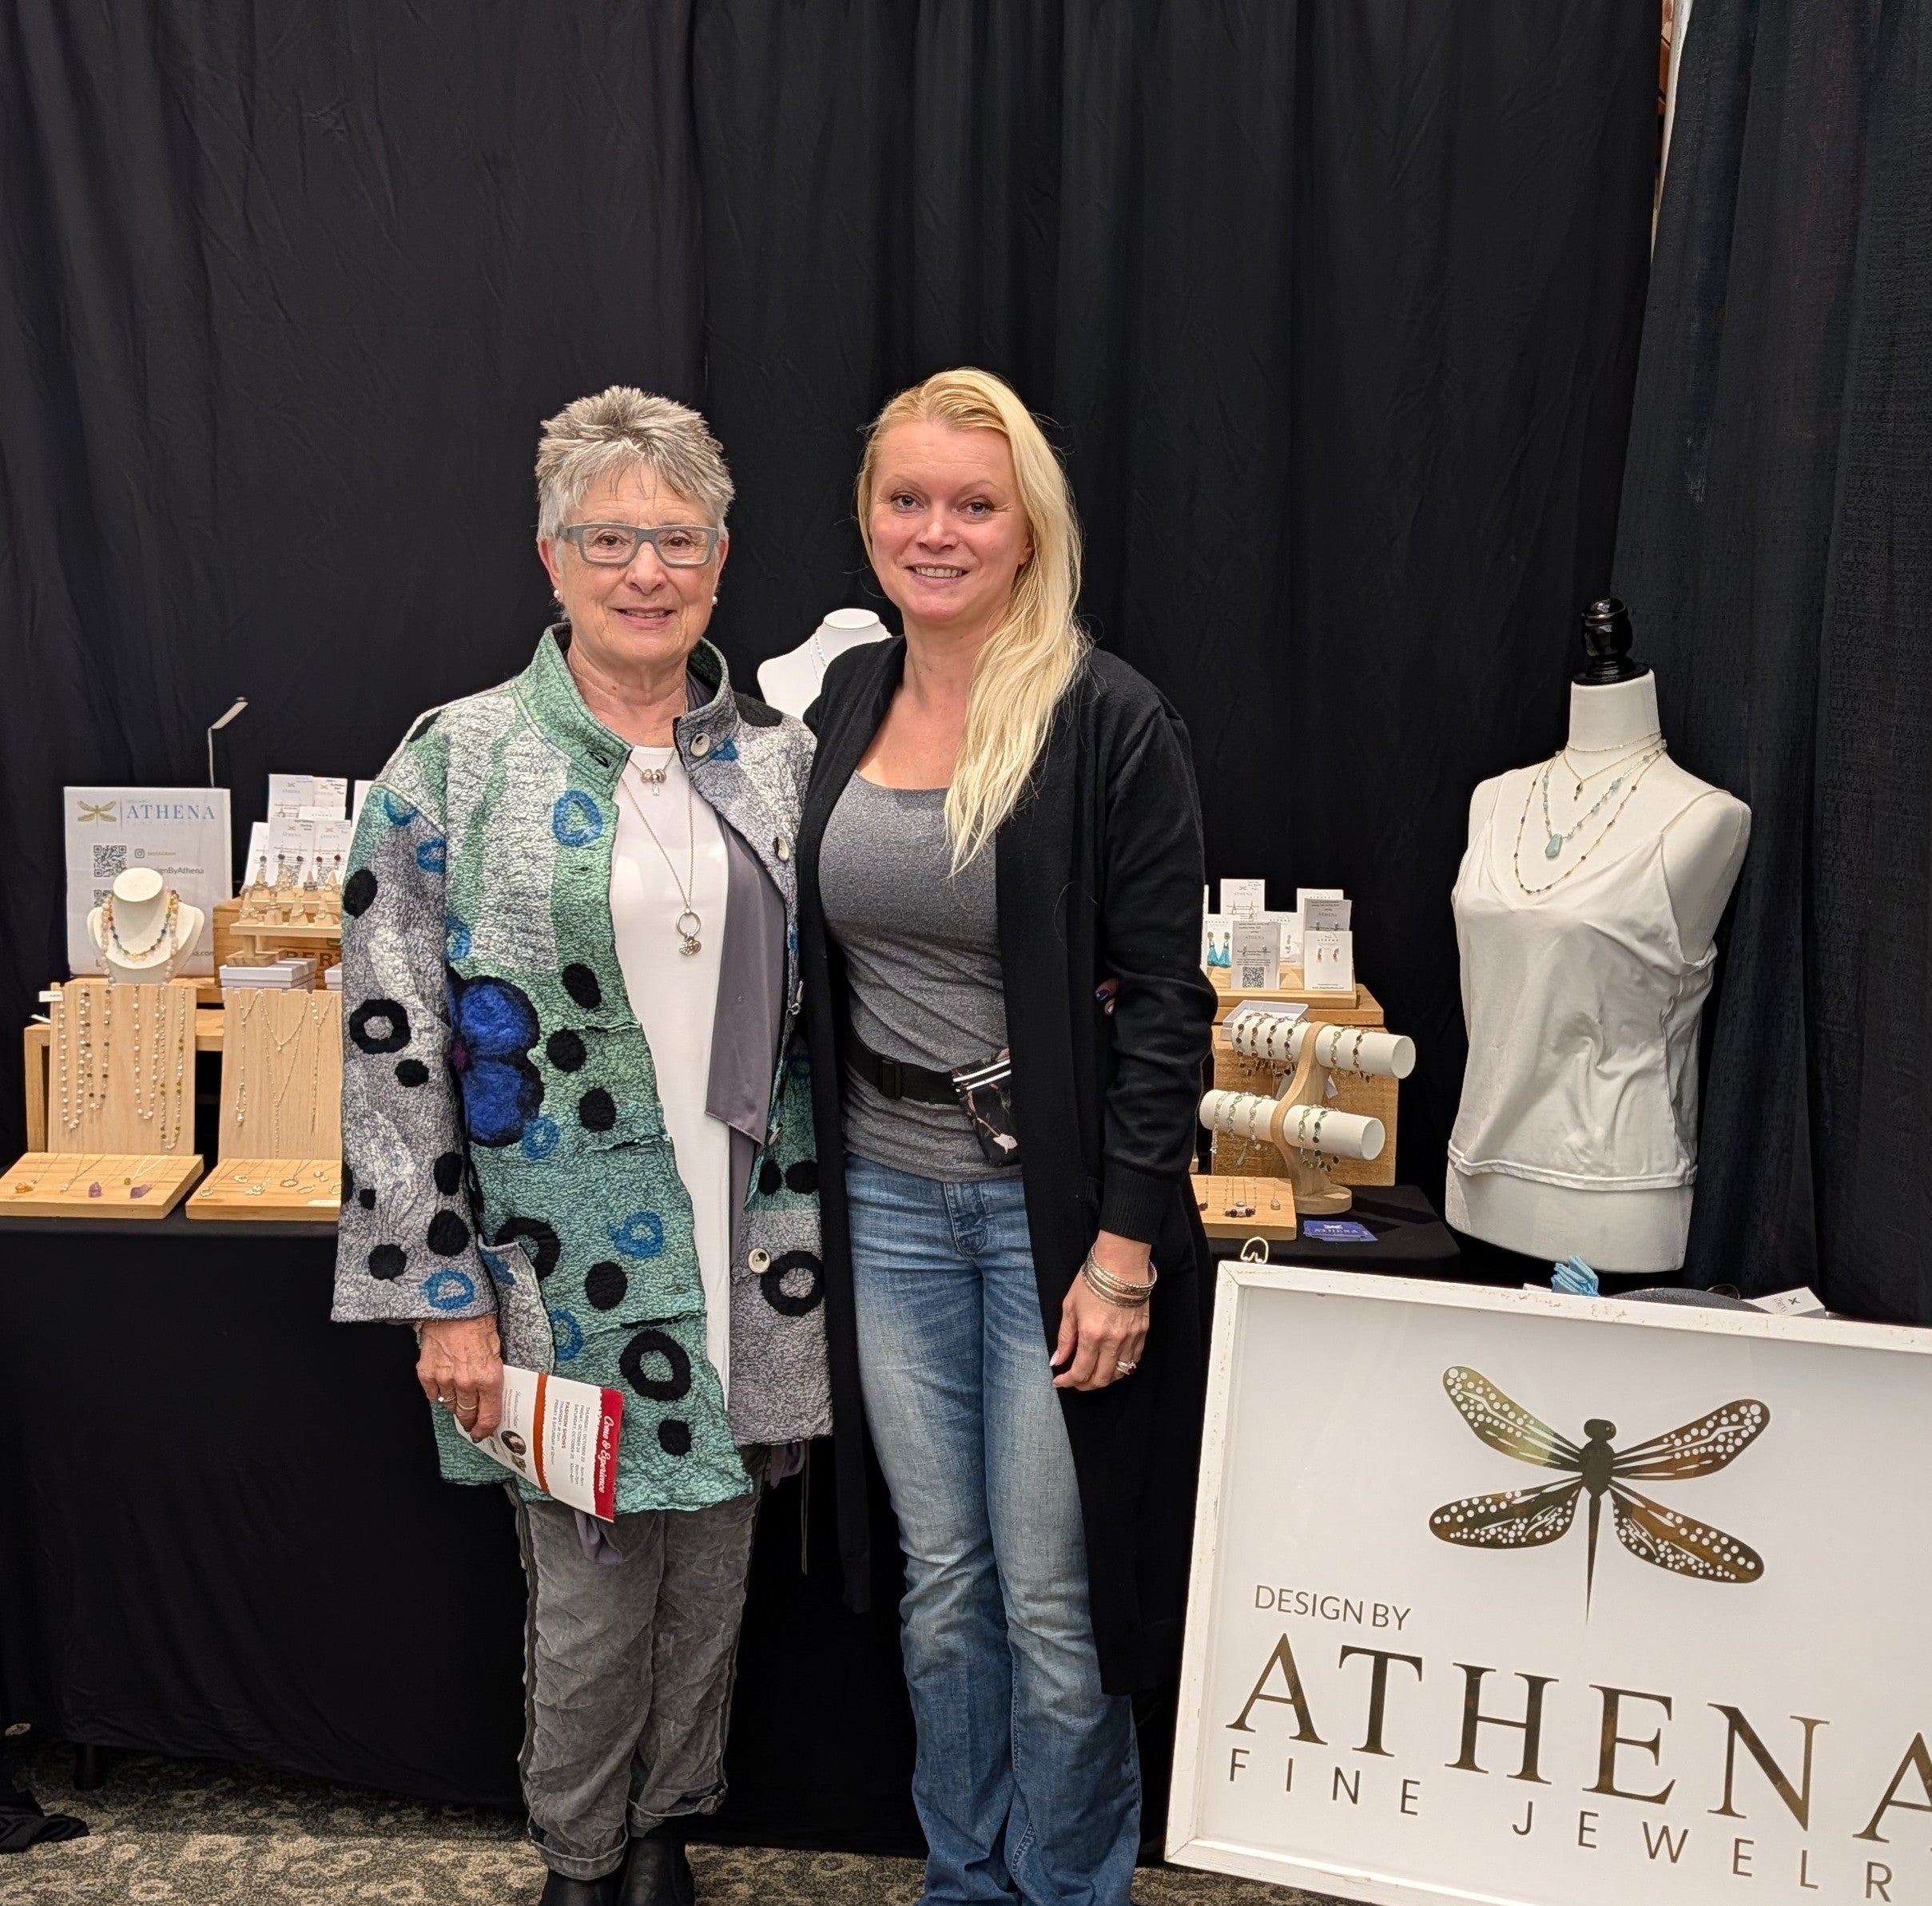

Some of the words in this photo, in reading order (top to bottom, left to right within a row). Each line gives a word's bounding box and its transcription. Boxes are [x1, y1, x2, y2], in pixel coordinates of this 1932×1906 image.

[126, 804, 215, 820] ATHENA
[602, 1440, 611, 1450] &
[603, 1416, 614, 1439] Come
[598, 1450, 611, 1494] Experience
[1255, 1585, 1364, 1625] DESIGN
[1372, 1602, 1412, 1631] BY
[1225, 1633, 1932, 1843] ATHENA
[1229, 1747, 1421, 1817] FINE
[1512, 1801, 1932, 1904] JEWELR
